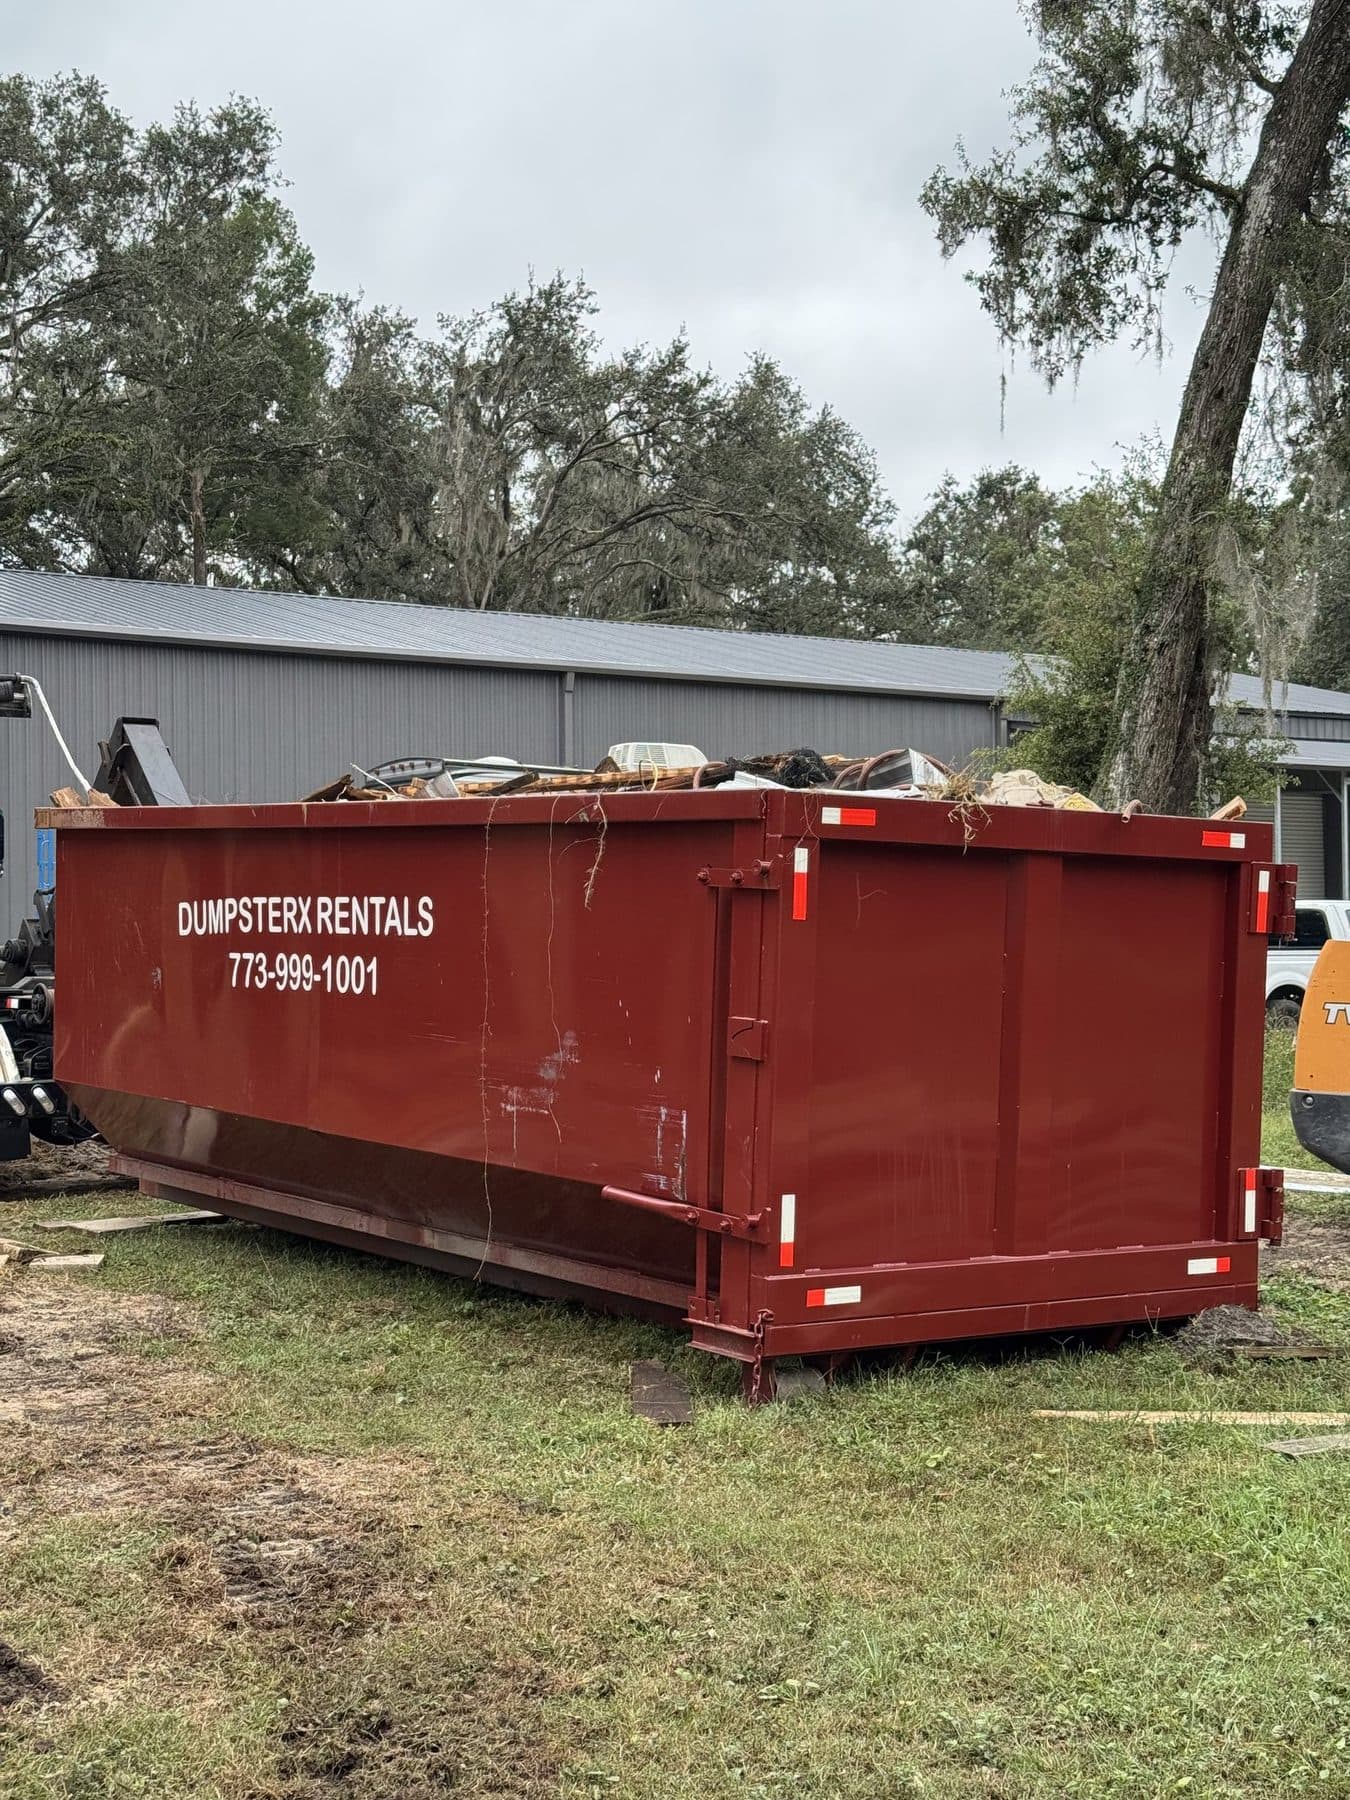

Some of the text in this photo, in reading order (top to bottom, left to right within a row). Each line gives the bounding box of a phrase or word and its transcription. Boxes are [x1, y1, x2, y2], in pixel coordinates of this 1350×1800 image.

[178, 896, 434, 937] DUMPSTERX RENTALS
[229, 952, 379, 996] 773-999-1001
